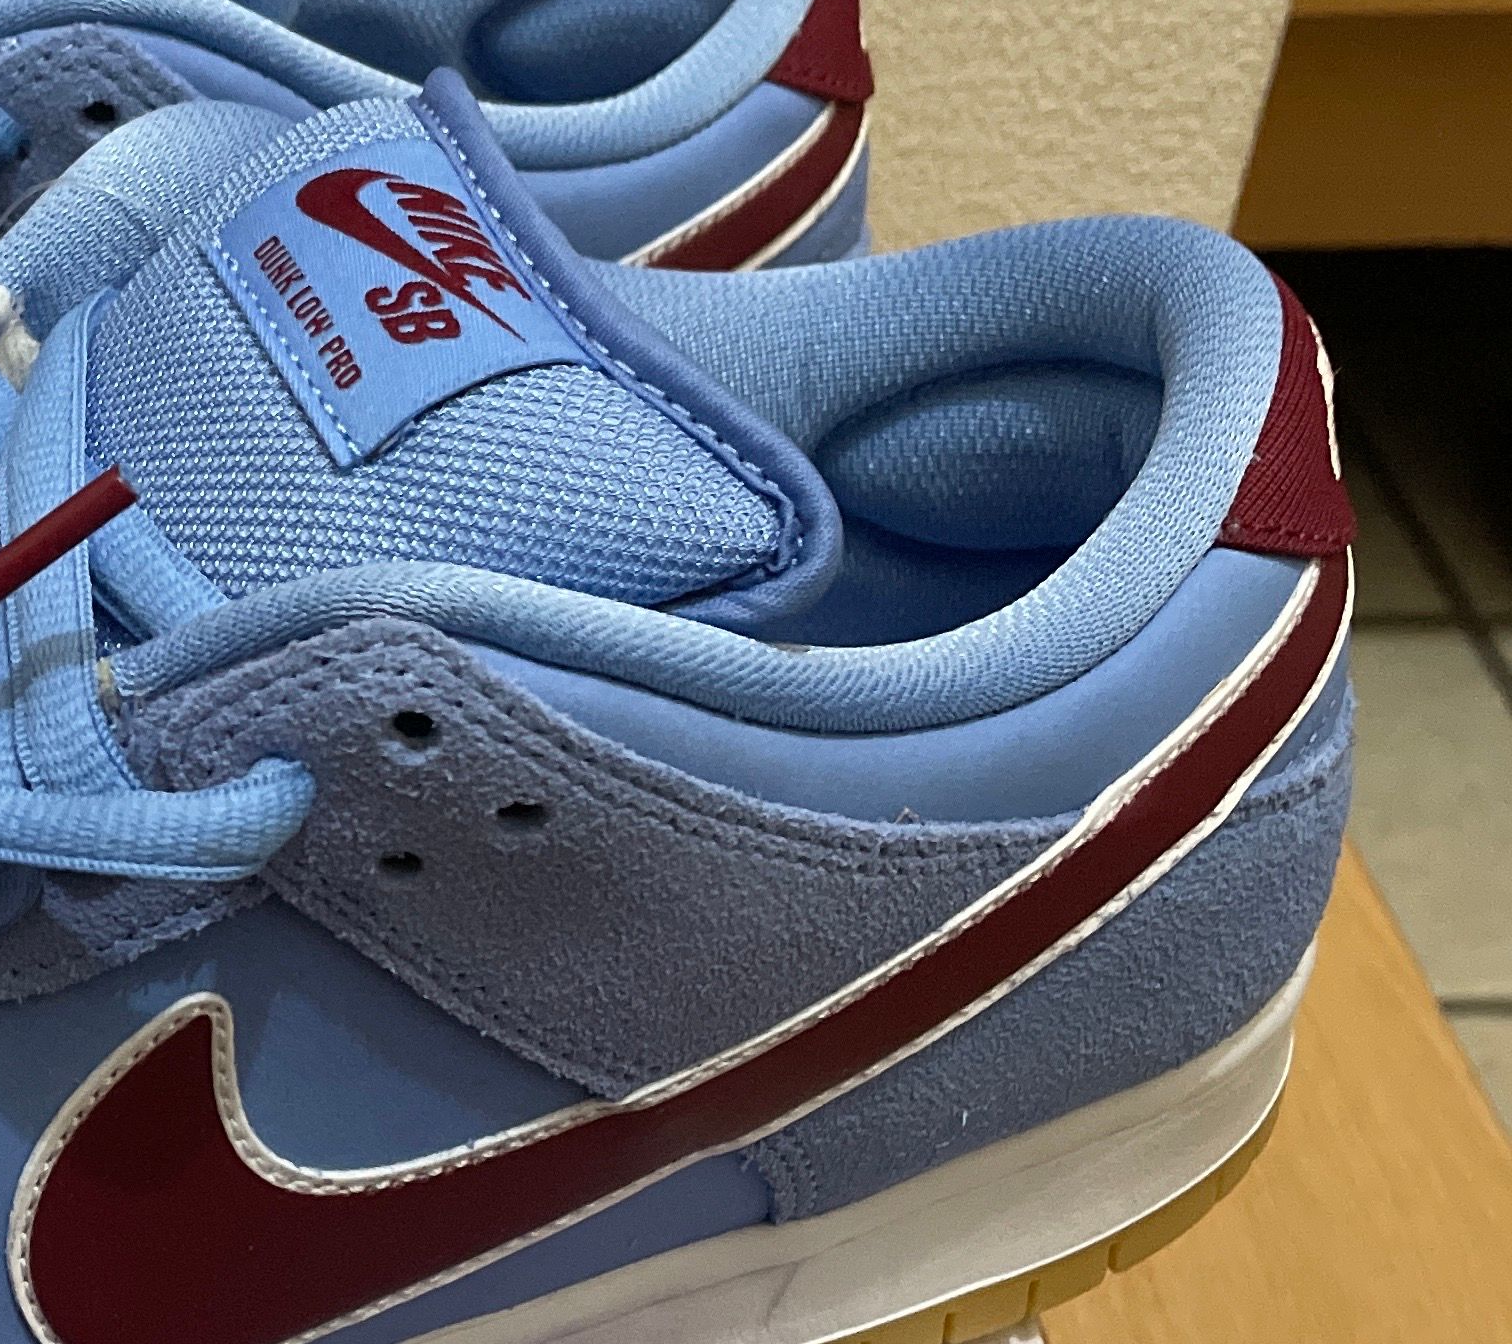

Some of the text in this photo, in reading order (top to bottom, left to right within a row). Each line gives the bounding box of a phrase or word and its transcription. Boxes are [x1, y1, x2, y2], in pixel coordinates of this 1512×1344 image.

[386, 181, 534, 302] NIKE
[253, 235, 362, 390] DUNK LOW PRO
[364, 281, 462, 345] SB
